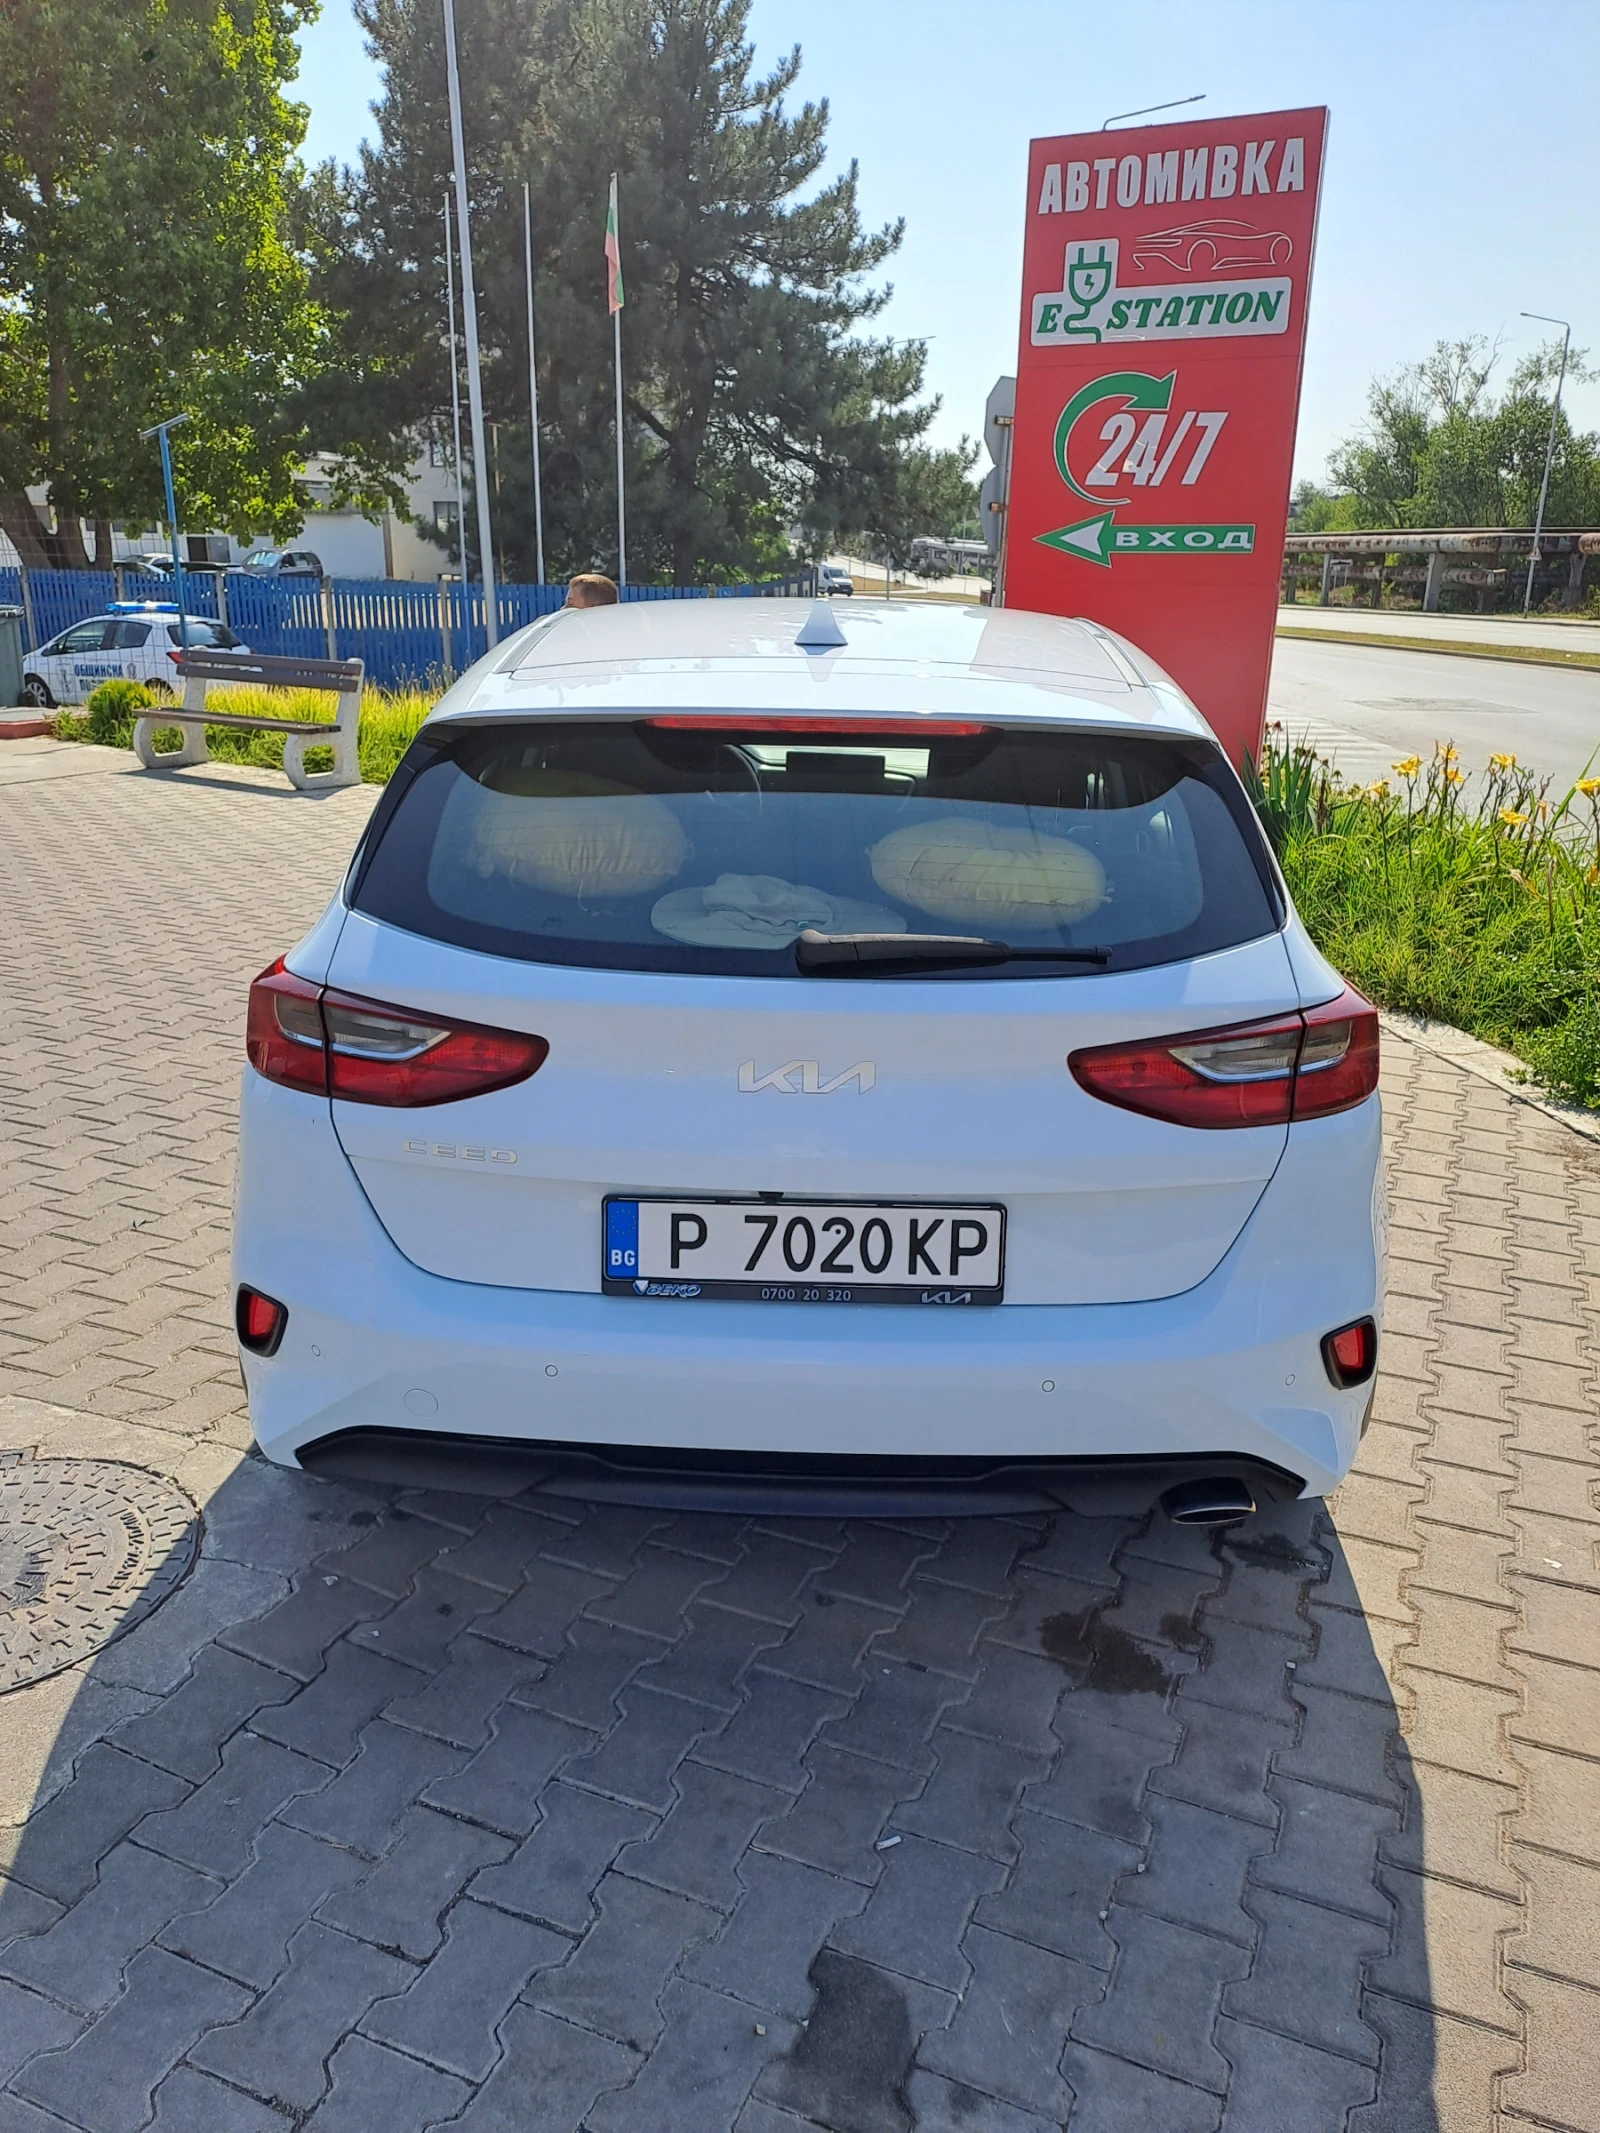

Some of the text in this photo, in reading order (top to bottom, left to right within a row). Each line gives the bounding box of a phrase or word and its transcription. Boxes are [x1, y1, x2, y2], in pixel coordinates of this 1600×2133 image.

[1038, 138, 1305, 215] АВТОМИВКА
[1036, 290, 1285, 334] E STATION
[1084, 410, 1230, 487] 24/7
[1115, 530, 1253, 550] ВХОД
[74, 664, 123, 677] ОБЩИНСКА
[738, 1059, 877, 1095] KIA
[403, 1138, 518, 1165] CEED
[610, 1249, 636, 1267] BG
[744, 1214, 893, 1274] 7020
[761, 1287, 852, 1302] 0700 20 320
